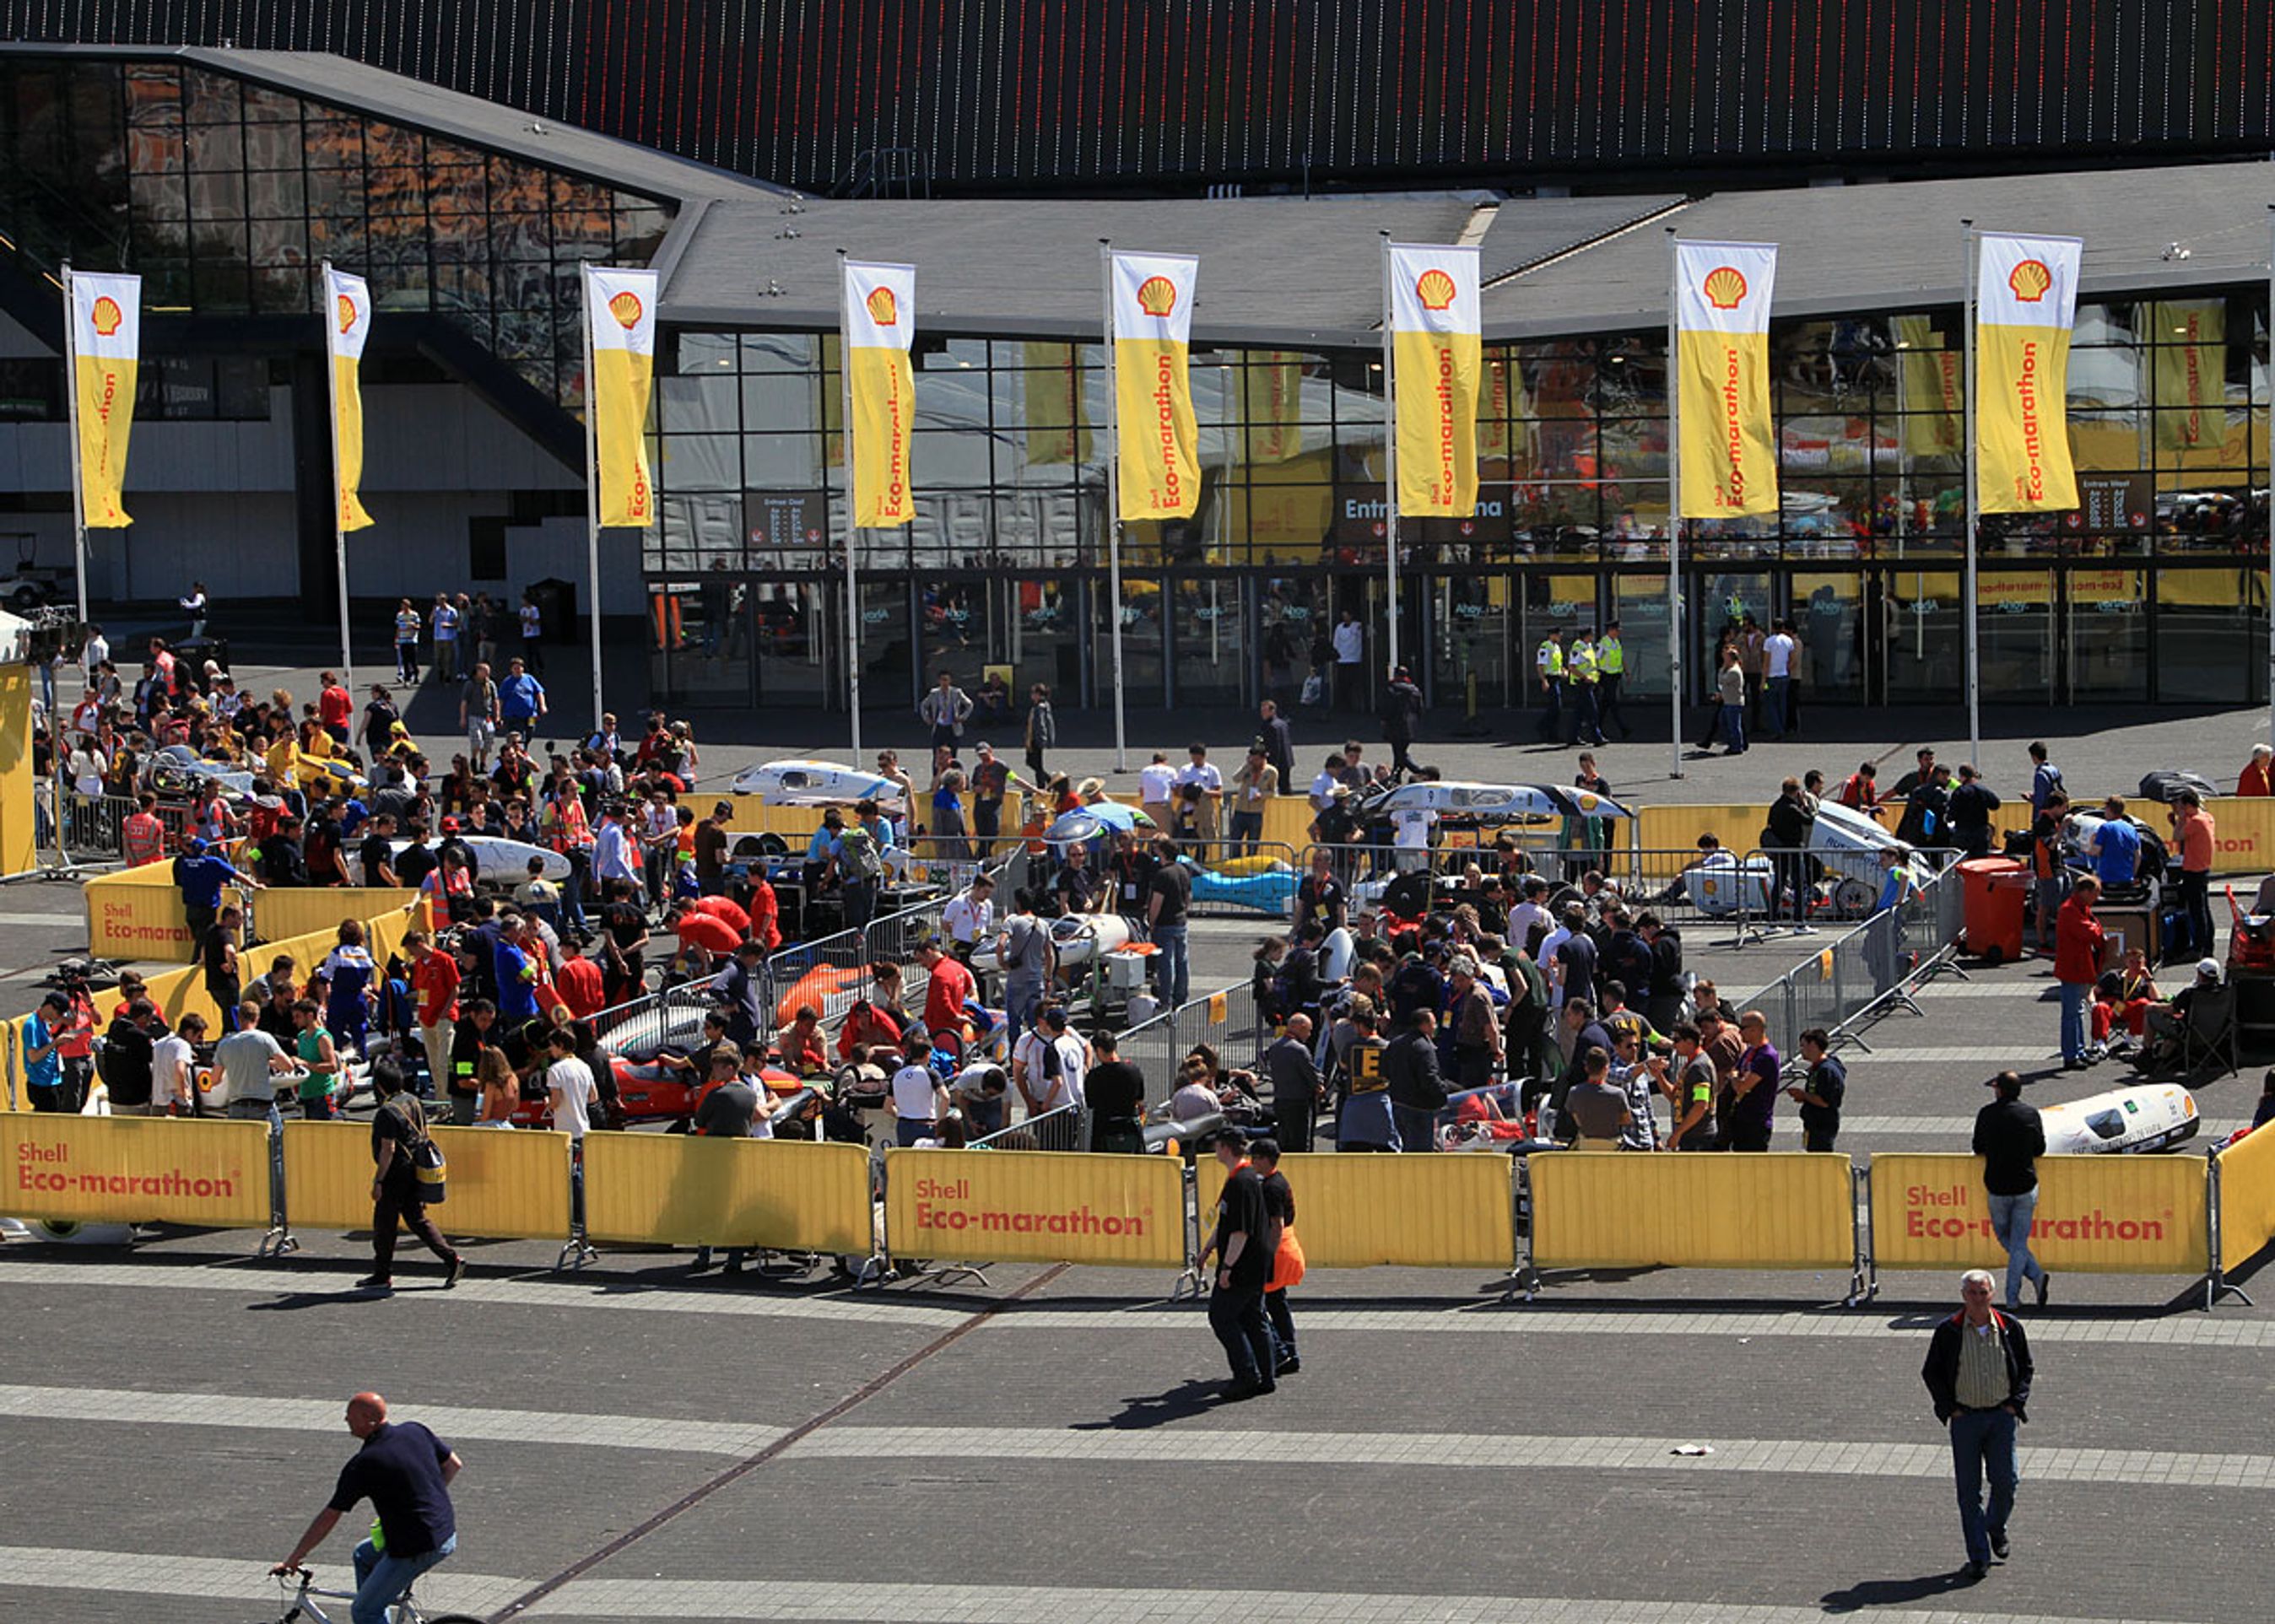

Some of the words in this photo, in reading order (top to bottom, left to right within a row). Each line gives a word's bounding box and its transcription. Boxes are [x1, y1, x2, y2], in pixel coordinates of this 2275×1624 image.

[1154, 354, 1181, 508] Eco-marathon
[1435, 348, 1454, 505] Eco-marathon
[1720, 348, 1743, 507] Eco-marathon
[2017, 342, 2043, 501] Eco-marathon
[105, 903, 132, 918] Shell
[18, 1142, 68, 1163] Shell
[18, 1164, 232, 1198] Eco-marathon
[916, 1179, 969, 1200] Shell
[1906, 1185, 1966, 1206] Shell
[916, 1202, 1143, 1237] Eco-marathon
[1906, 1210, 2164, 1241] Eco-rathon
